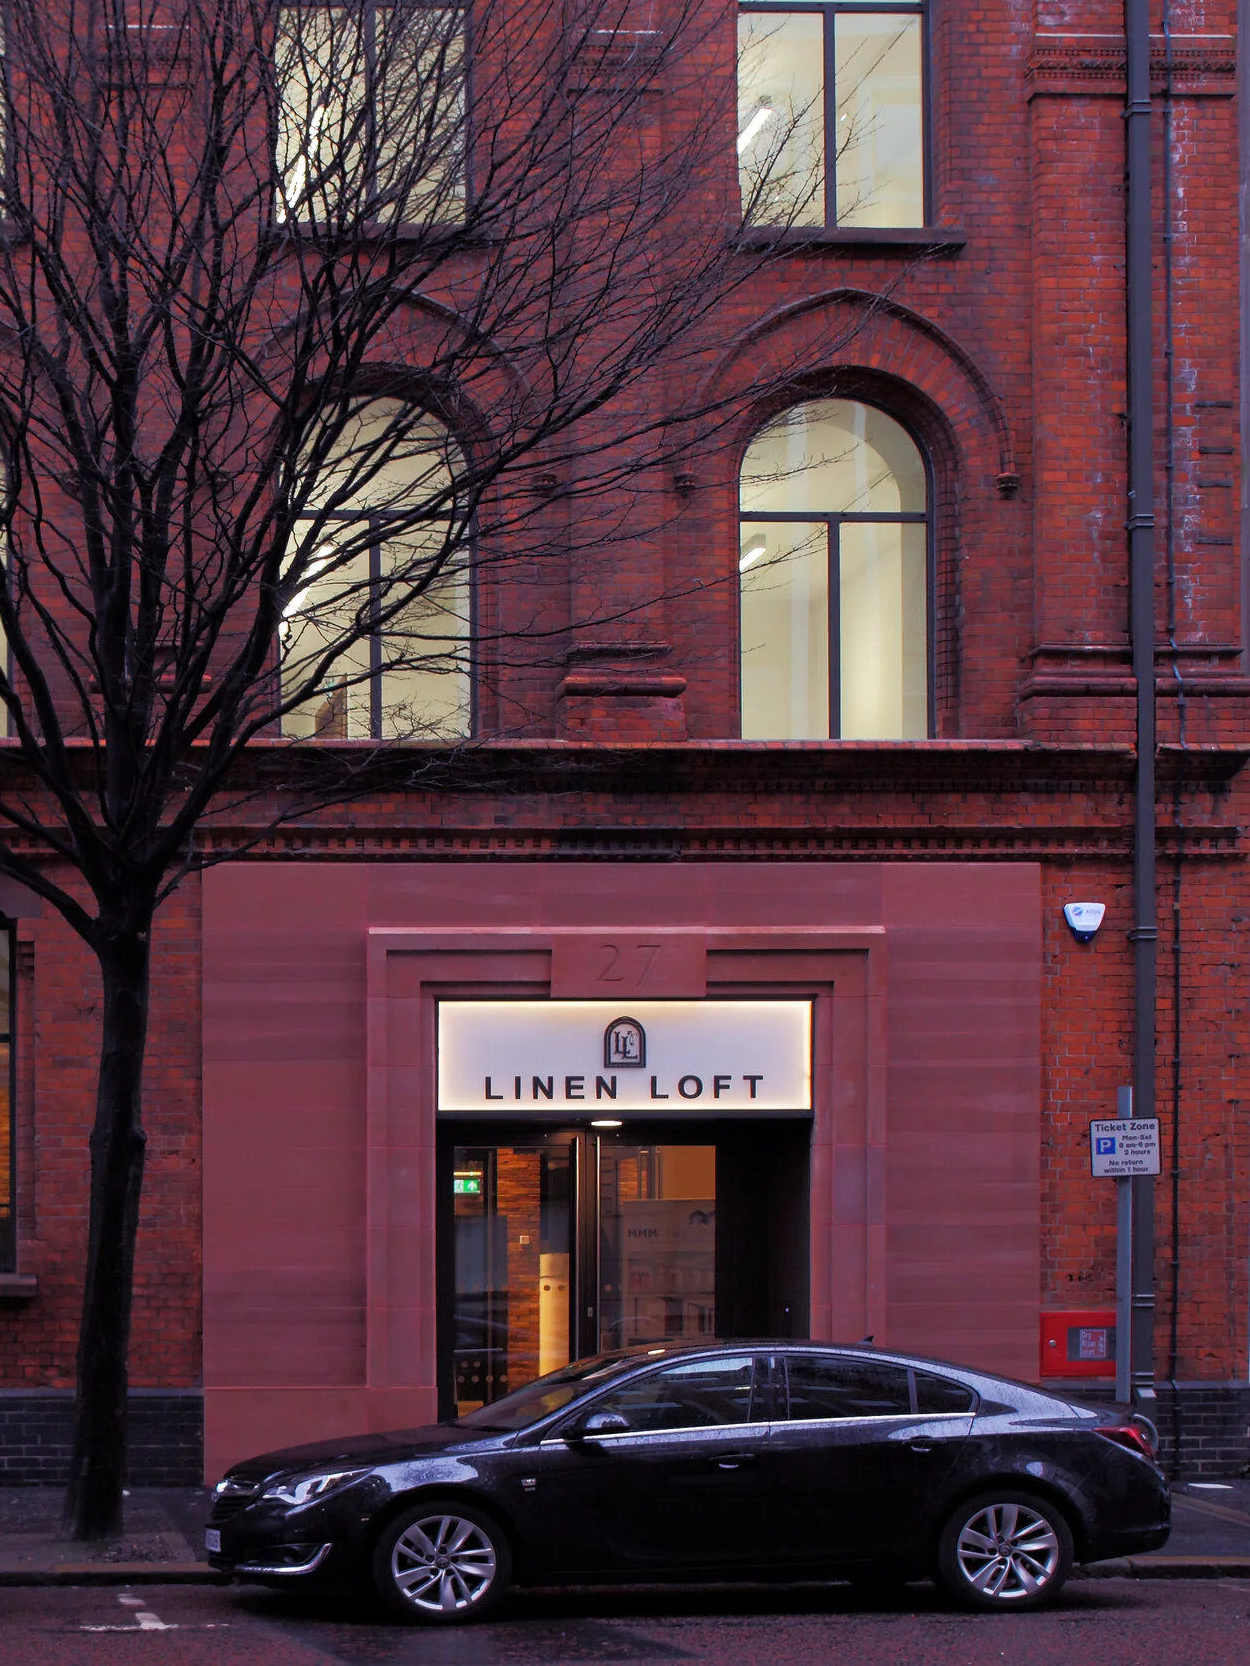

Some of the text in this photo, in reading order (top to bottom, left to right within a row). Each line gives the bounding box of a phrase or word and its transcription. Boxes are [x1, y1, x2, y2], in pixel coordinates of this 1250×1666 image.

[597, 944, 661, 986] 27
[484, 1074, 764, 1100] LINEN LOFT
[1095, 1122, 1156, 1132] Ticket Zone
[1100, 1139, 1111, 1153] P
